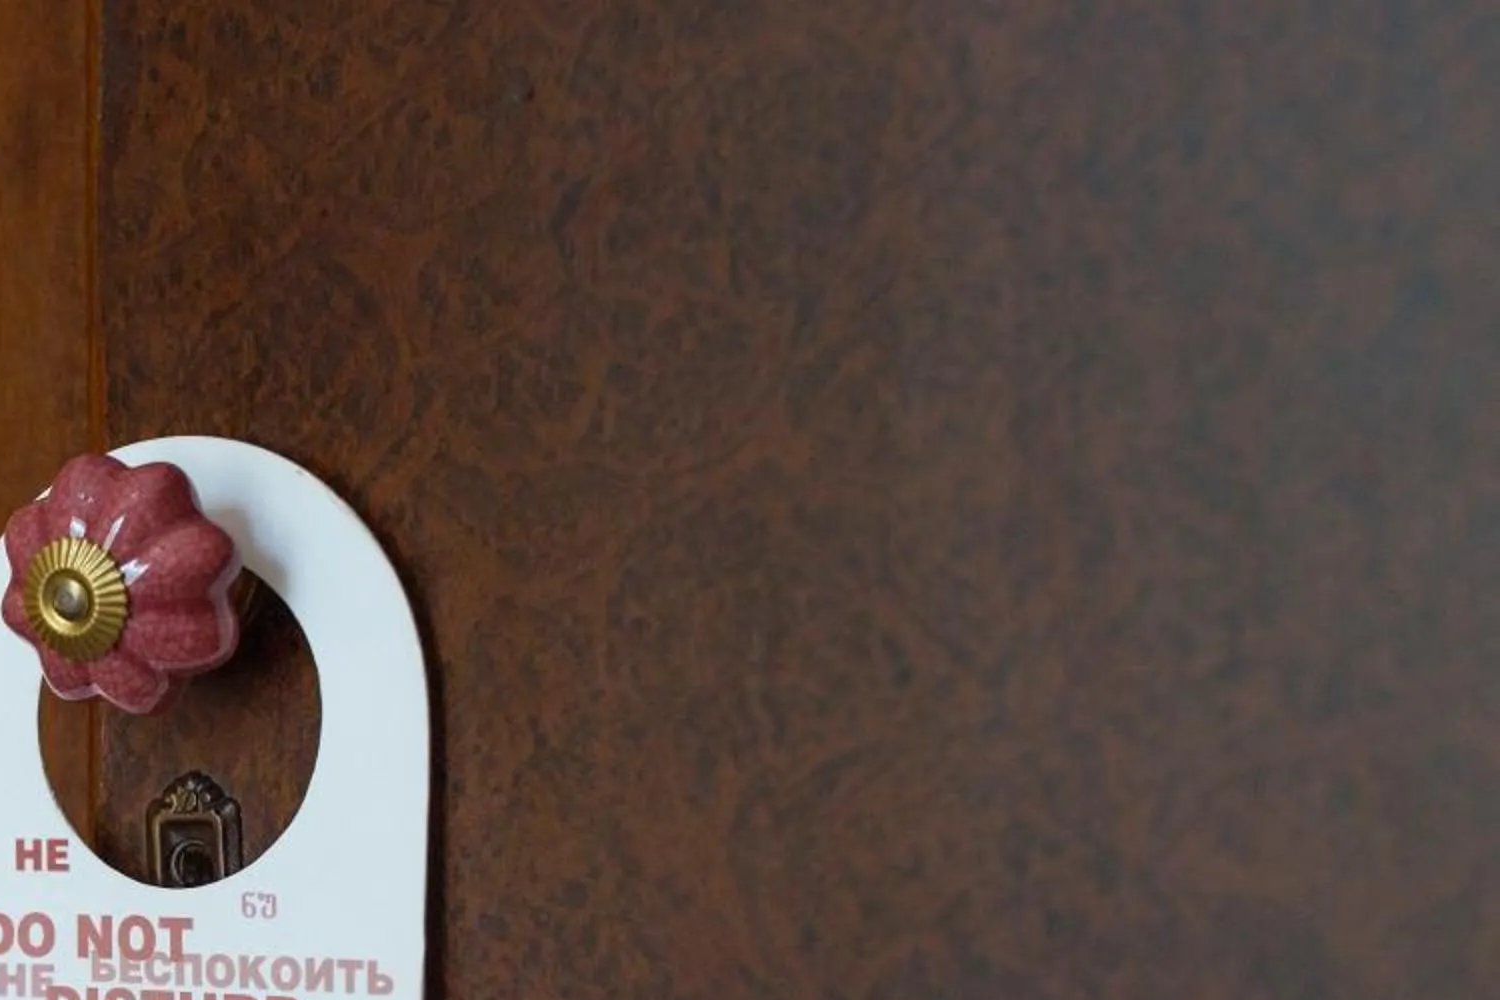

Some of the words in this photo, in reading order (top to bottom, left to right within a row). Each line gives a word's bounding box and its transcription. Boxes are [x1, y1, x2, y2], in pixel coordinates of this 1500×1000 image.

[14, 838, 70, 872] НЕ
[241, 891, 277, 919] ნუ
[76, 913, 194, 962] NOT
[91, 951, 395, 995] БЕСПОКОИТЬ
